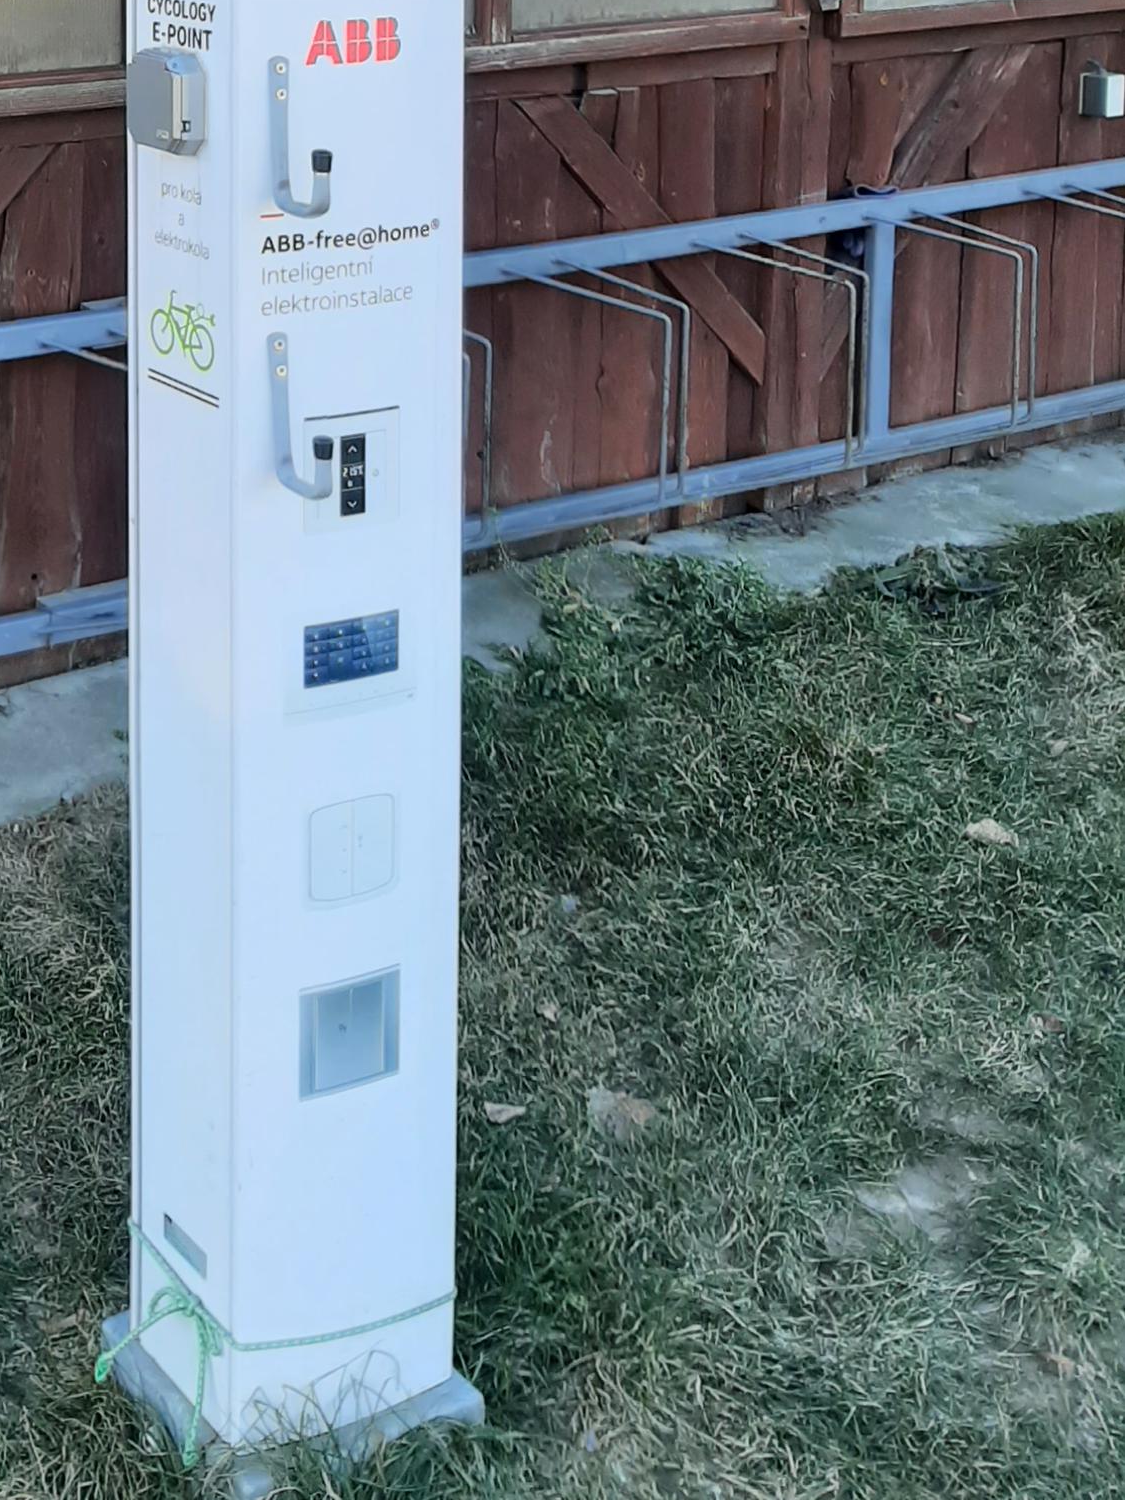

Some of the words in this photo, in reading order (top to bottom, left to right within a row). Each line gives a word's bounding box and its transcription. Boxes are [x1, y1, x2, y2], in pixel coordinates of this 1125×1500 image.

[152, 21, 213, 51] E-POINT
[305, 16, 402, 66] ABB
[161, 180, 178, 199] pro
[180, 186, 202, 206] kola
[178, 213, 185, 227] a
[154, 228, 210, 260] elektrokola
[261, 256, 374, 286] Inteligentní
[261, 285, 414, 317] elektroinstalace
